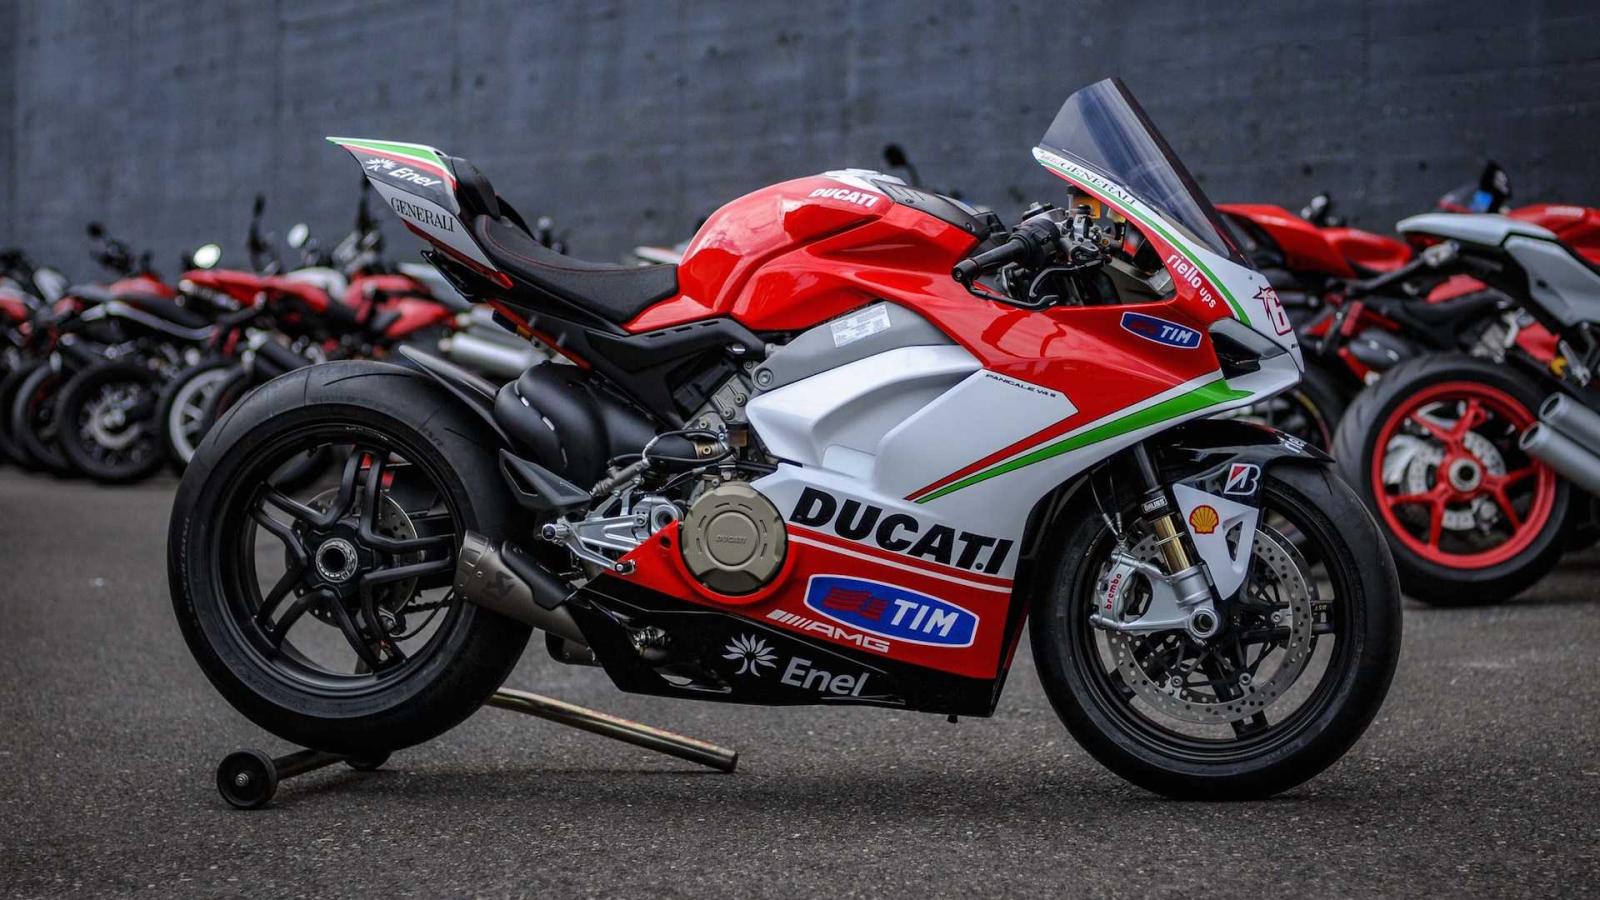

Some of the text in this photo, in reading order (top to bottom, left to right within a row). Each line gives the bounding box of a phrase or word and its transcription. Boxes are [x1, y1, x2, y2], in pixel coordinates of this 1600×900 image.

[388, 167, 442, 187] Enel
[390, 197, 455, 232] GENERALI
[808, 188, 879, 208] DUCATI
[1166, 253, 1217, 309] riello ups
[1160, 325, 1194, 344] TIM
[789, 486, 1014, 574] DUCATI
[1104, 573, 1122, 610] brembo
[891, 598, 960, 638] TIM
[780, 656, 870, 697] Enel
